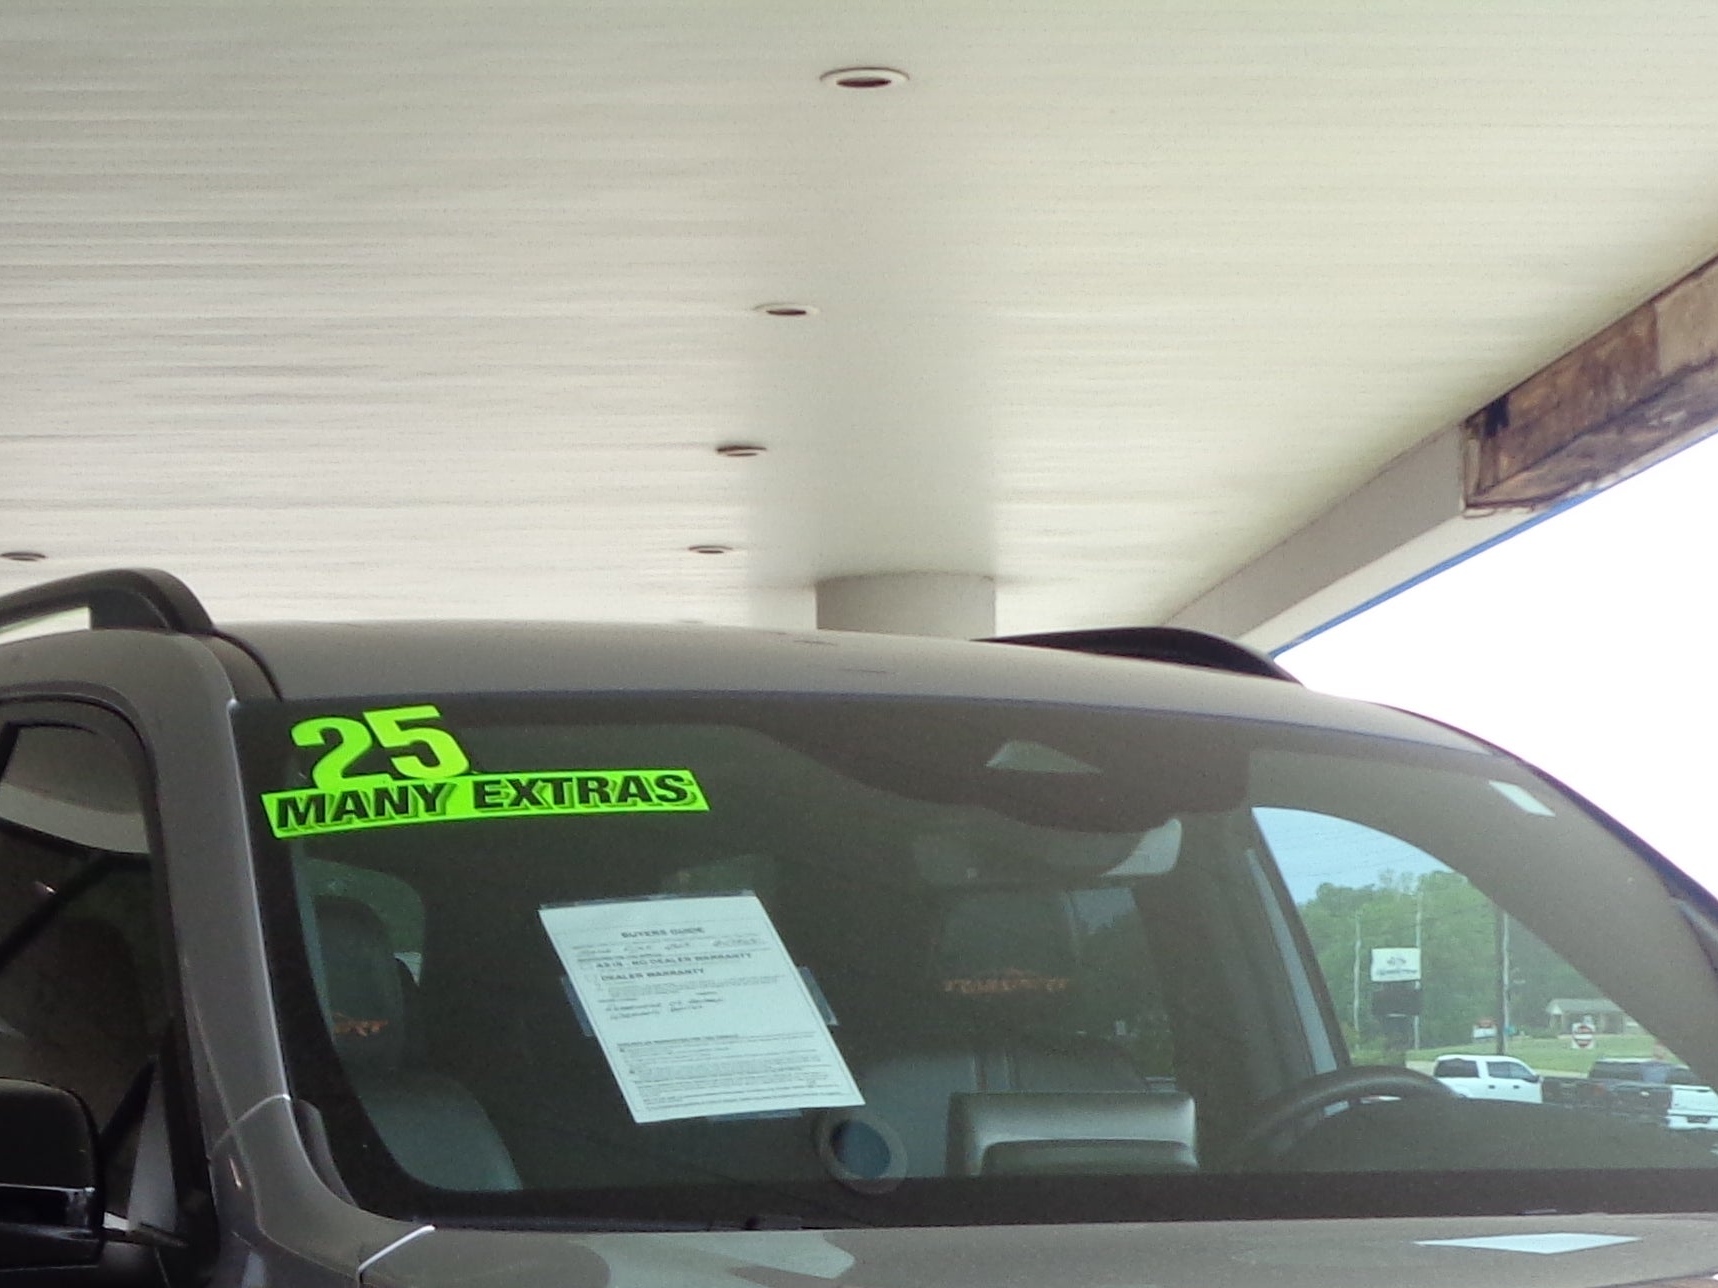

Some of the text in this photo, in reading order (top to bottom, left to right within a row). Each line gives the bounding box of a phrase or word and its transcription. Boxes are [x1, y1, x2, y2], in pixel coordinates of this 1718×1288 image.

[290, 704, 471, 789] 25
[279, 773, 696, 832] MANY EXTRAS
